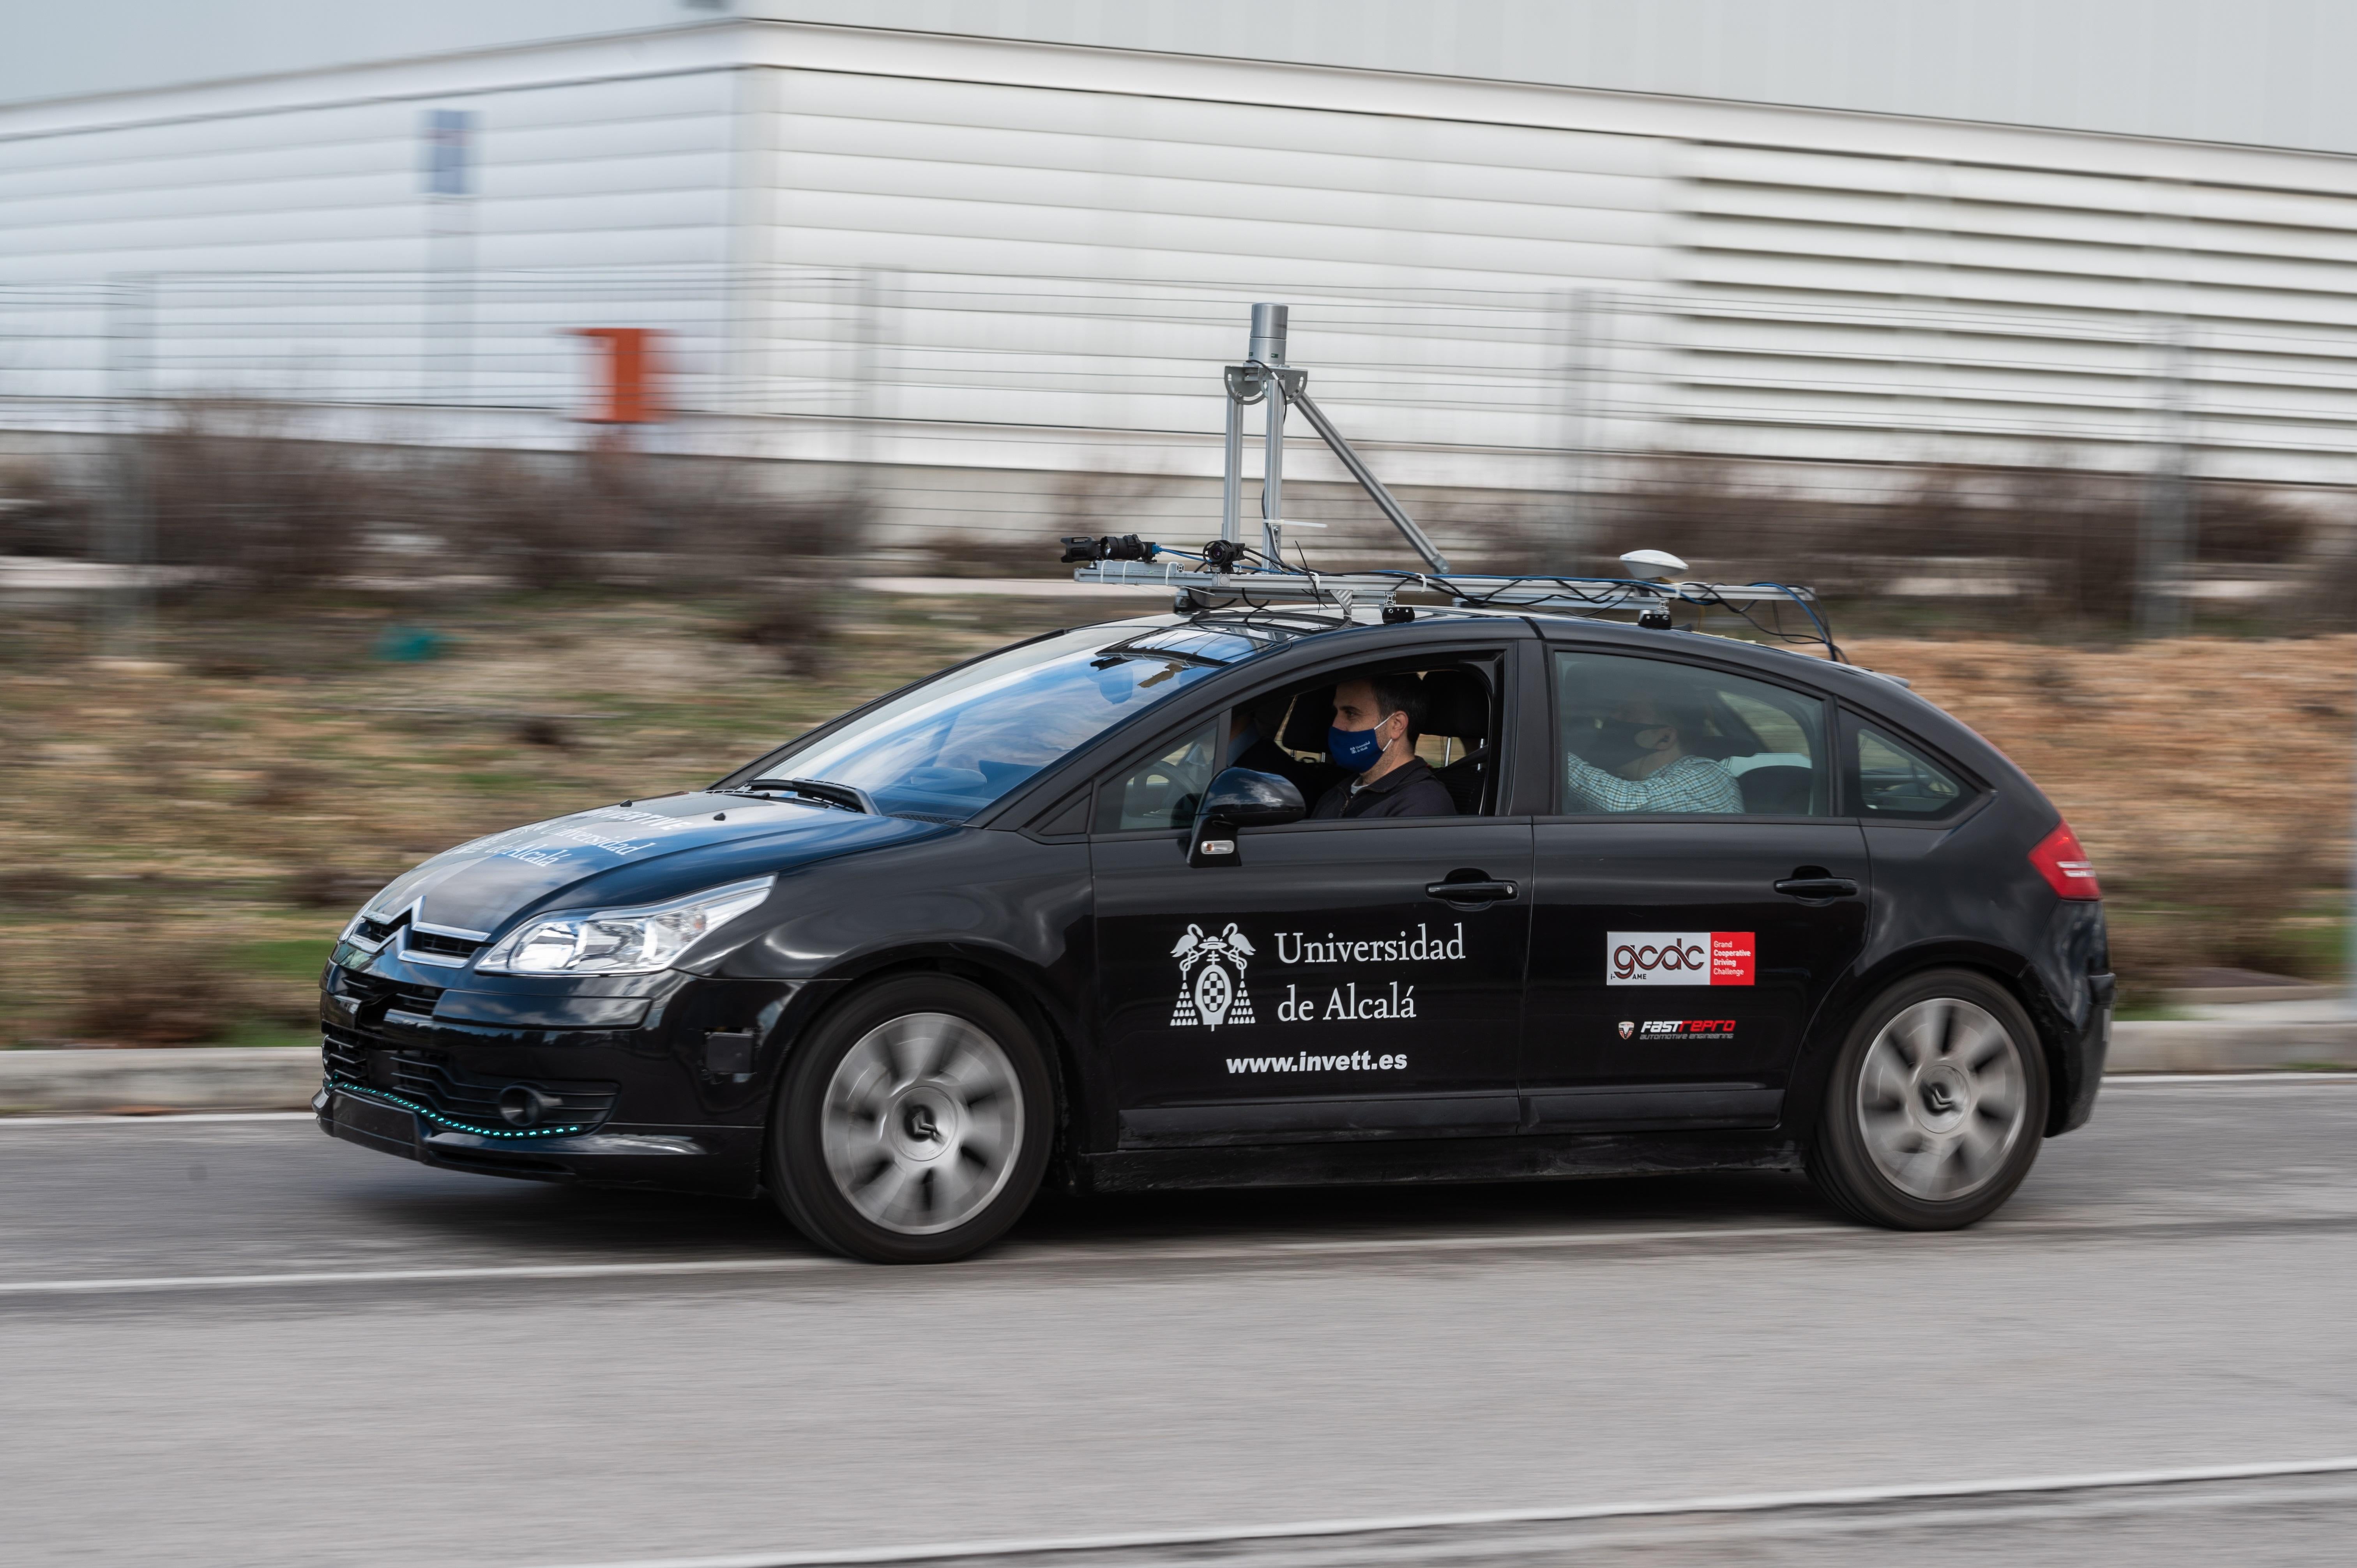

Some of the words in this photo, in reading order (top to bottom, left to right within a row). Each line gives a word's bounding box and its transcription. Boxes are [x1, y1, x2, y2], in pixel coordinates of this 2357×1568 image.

[484, 840, 523, 853] de
[540, 825, 657, 855] Universidad
[501, 844, 572, 867] Alcalá
[1274, 922, 1466, 963] Universidad
[1714, 949, 1751, 957] Cooperative
[1613, 938, 1705, 980] gcdc
[1714, 958, 1737, 967] Driving
[1713, 968, 1744, 976] Challenge
[1277, 984, 1314, 1021] de
[1322, 981, 1417, 1020] Alcalá
[1226, 1050, 1407, 1074] www.invett.es
